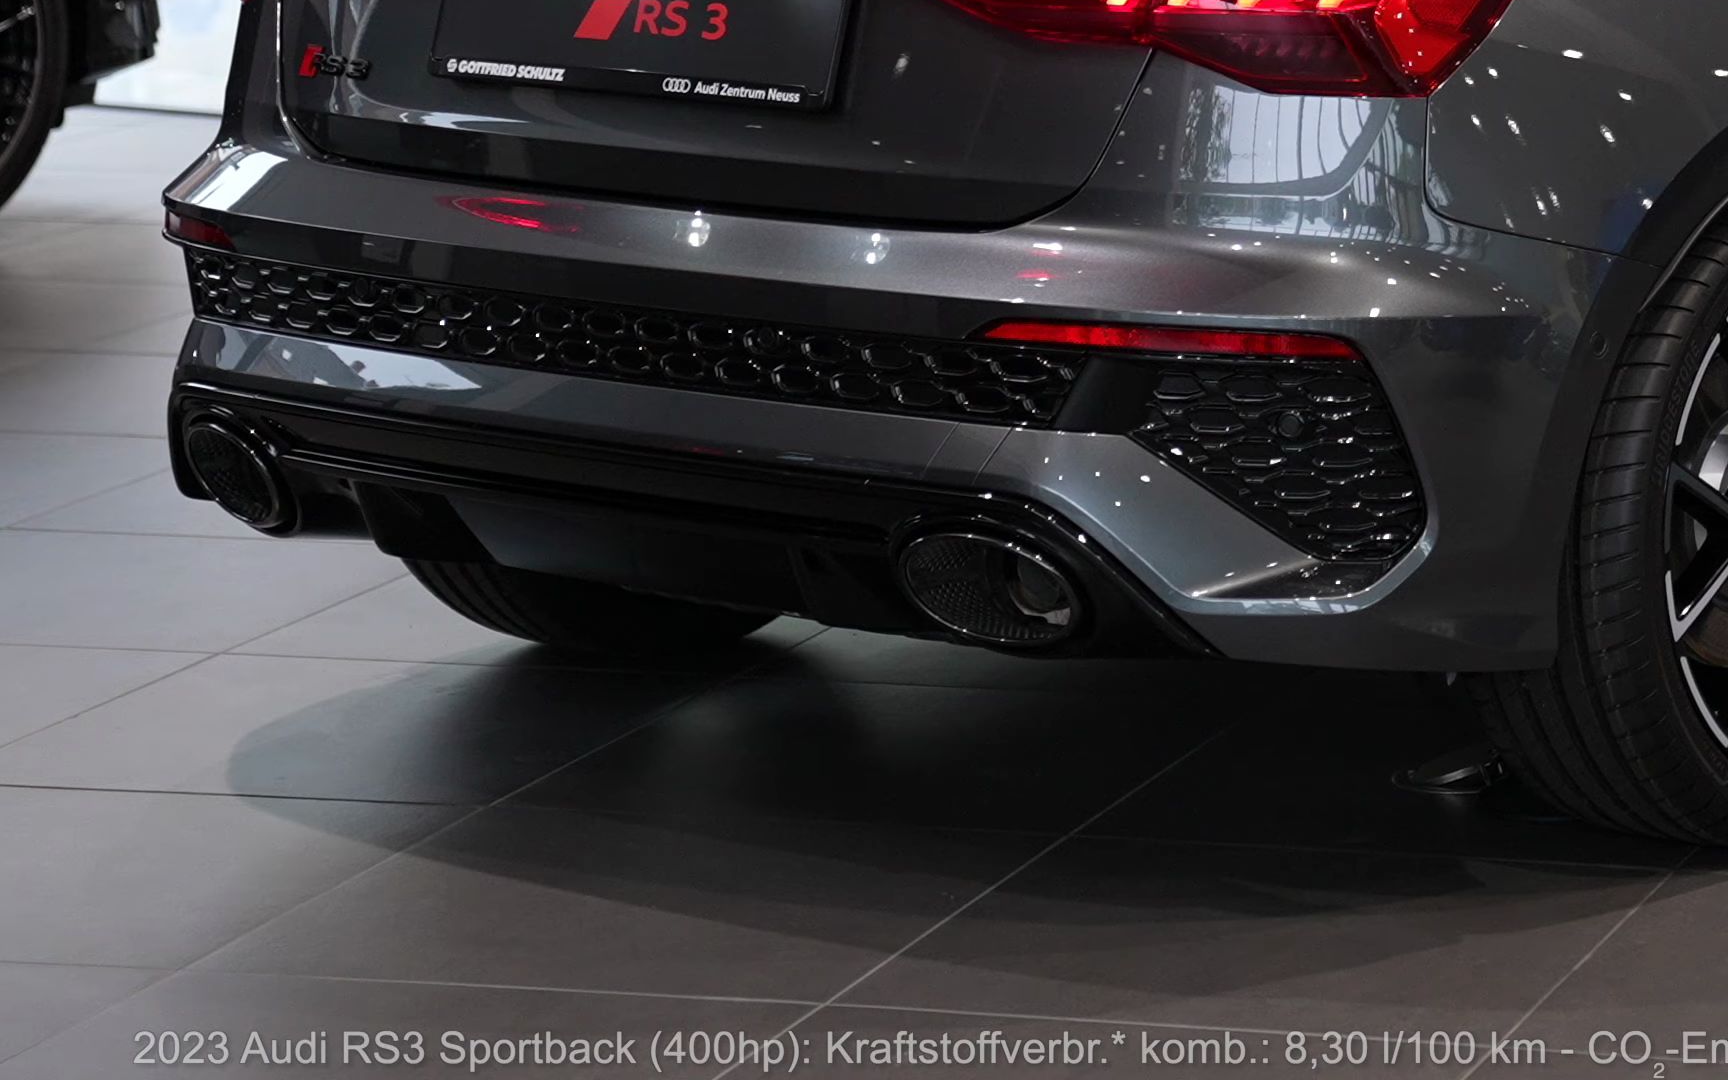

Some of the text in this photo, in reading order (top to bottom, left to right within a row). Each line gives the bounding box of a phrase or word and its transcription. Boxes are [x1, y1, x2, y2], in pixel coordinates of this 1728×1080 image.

[701, 2, 729, 41] 3
[458, 60, 566, 81] GOTTFRIED SCHULTZ
[694, 81, 800, 103] Audi Zentrum Neuss
